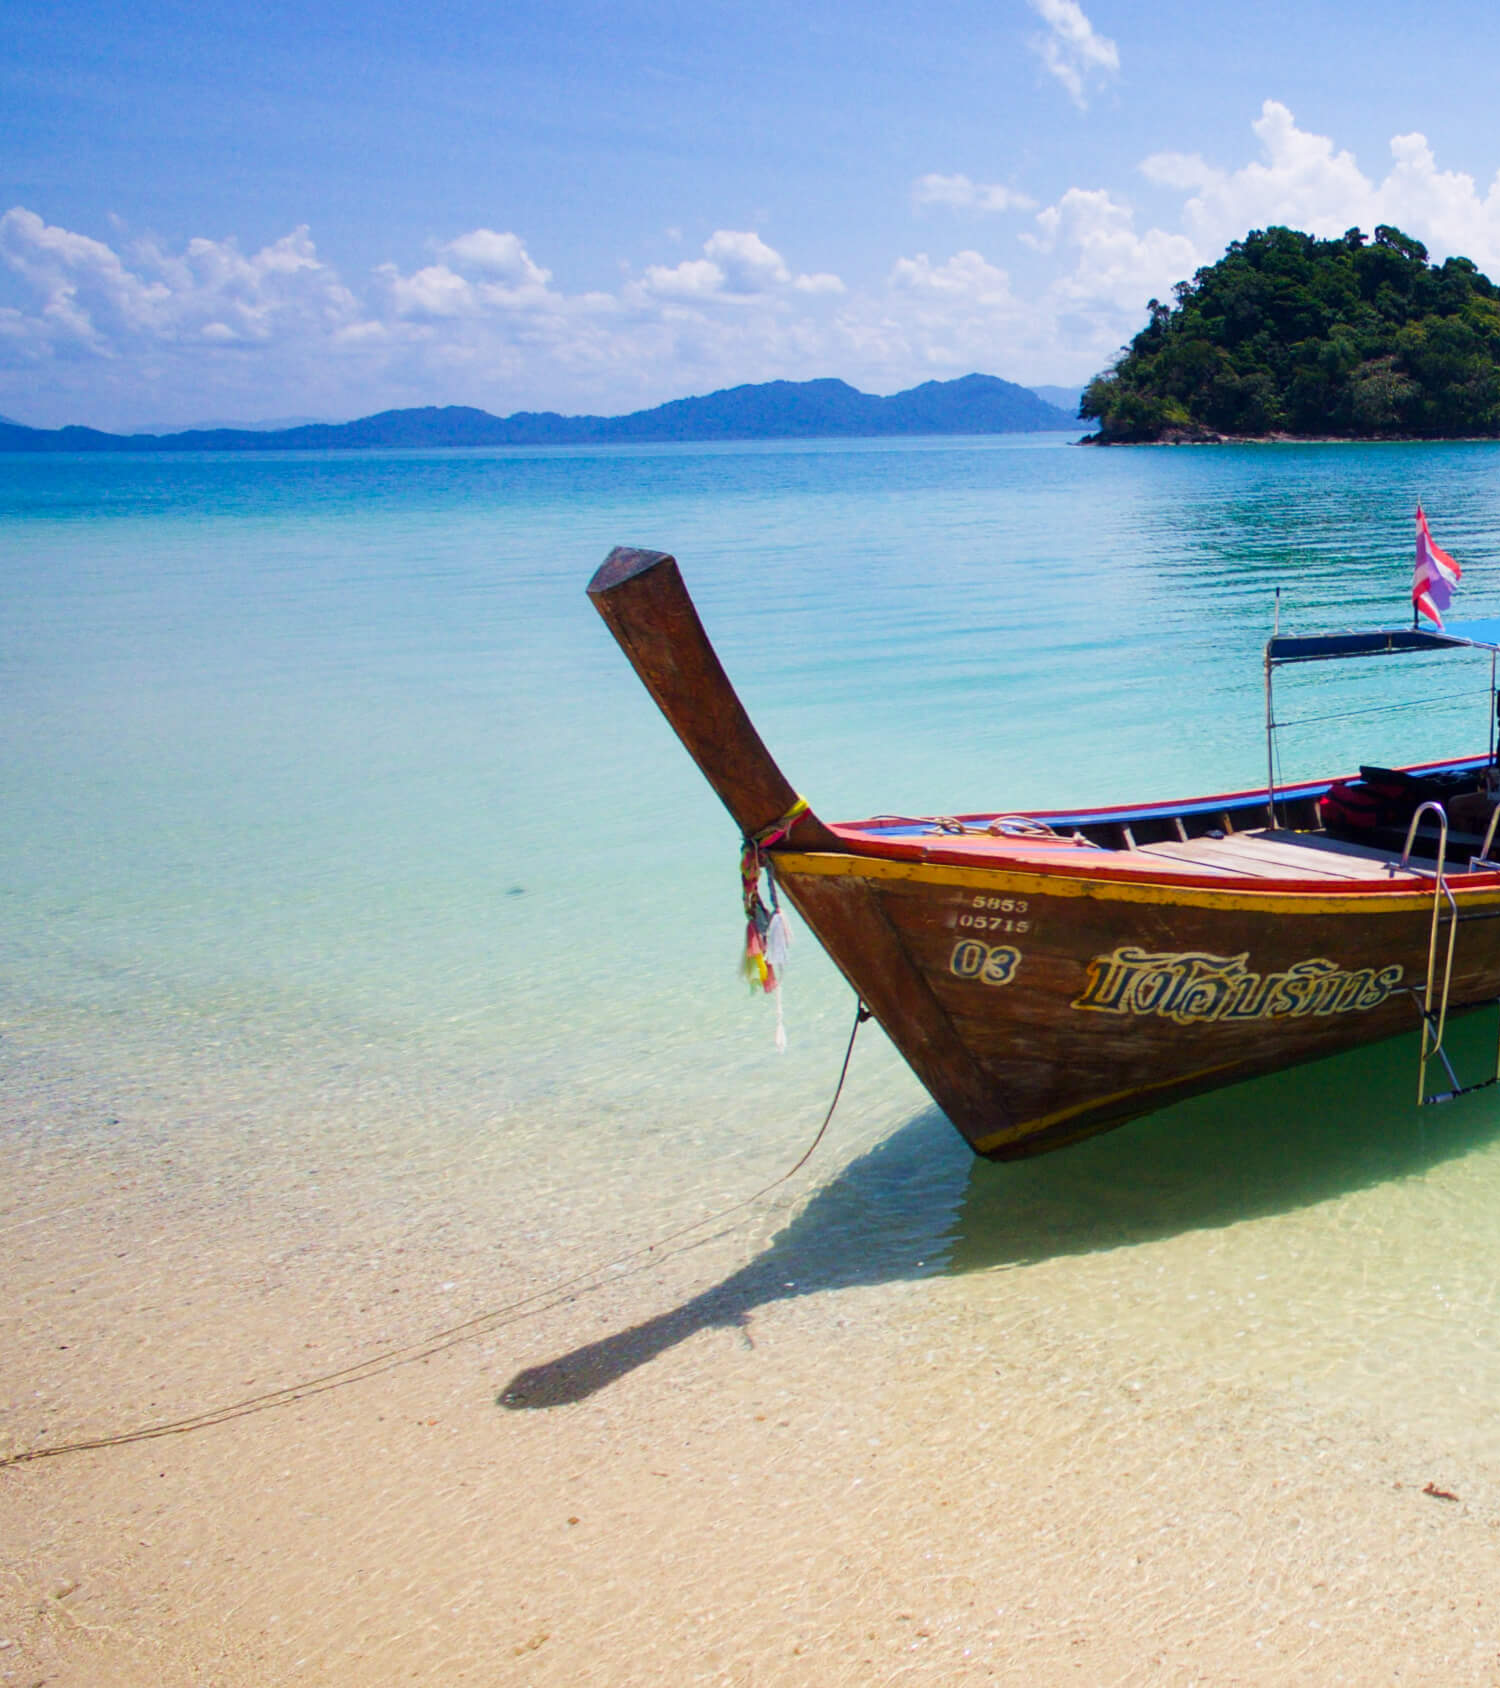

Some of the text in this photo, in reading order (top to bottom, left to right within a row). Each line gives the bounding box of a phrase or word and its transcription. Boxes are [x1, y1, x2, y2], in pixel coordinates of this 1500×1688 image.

[972, 896, 1028, 913] 5853
[959, 914, 1030, 933] 05715
[951, 939, 1022, 985] 03
